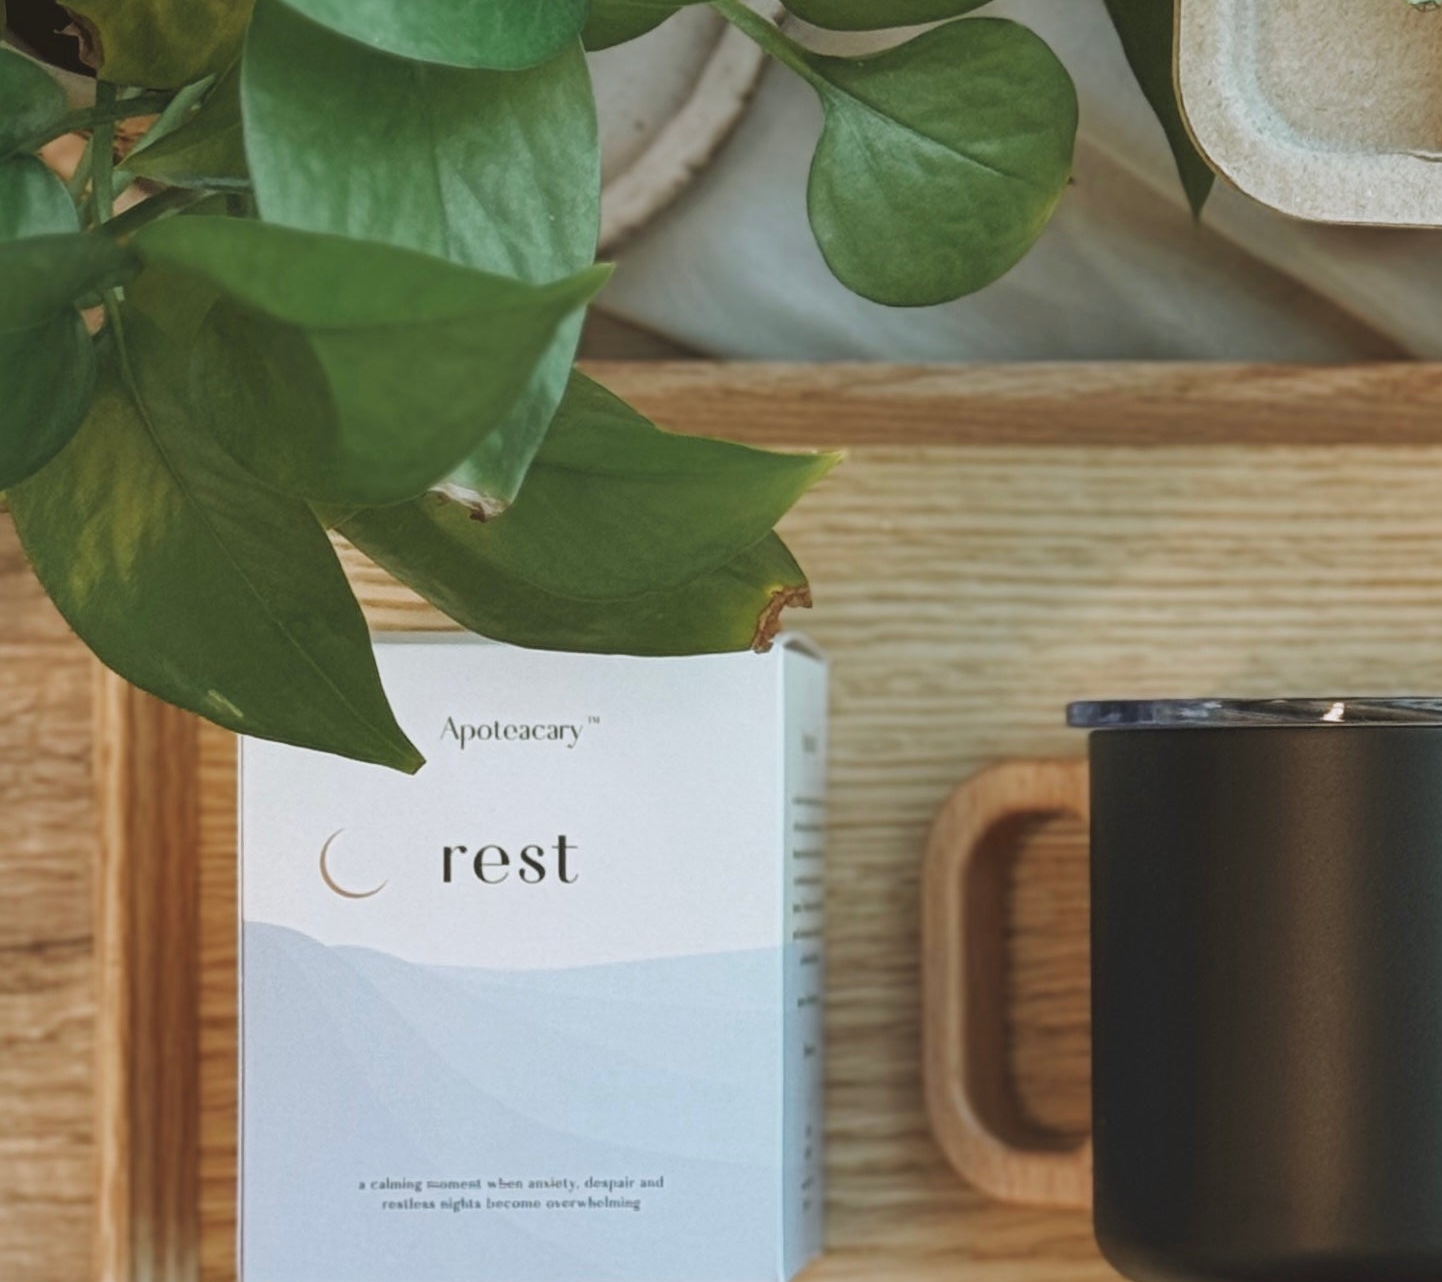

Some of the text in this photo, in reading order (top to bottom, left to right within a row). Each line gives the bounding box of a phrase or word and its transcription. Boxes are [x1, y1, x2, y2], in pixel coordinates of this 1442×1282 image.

[440, 834, 580, 885] rest
[370, 1178, 423, 1193] calming
[426, 1179, 482, 1191] moment
[487, 1178, 524, 1190] when
[584, 1176, 636, 1193] despair
[639, 1175, 665, 1189] and
[382, 1196, 642, 1214] restless nights become overwhelming
